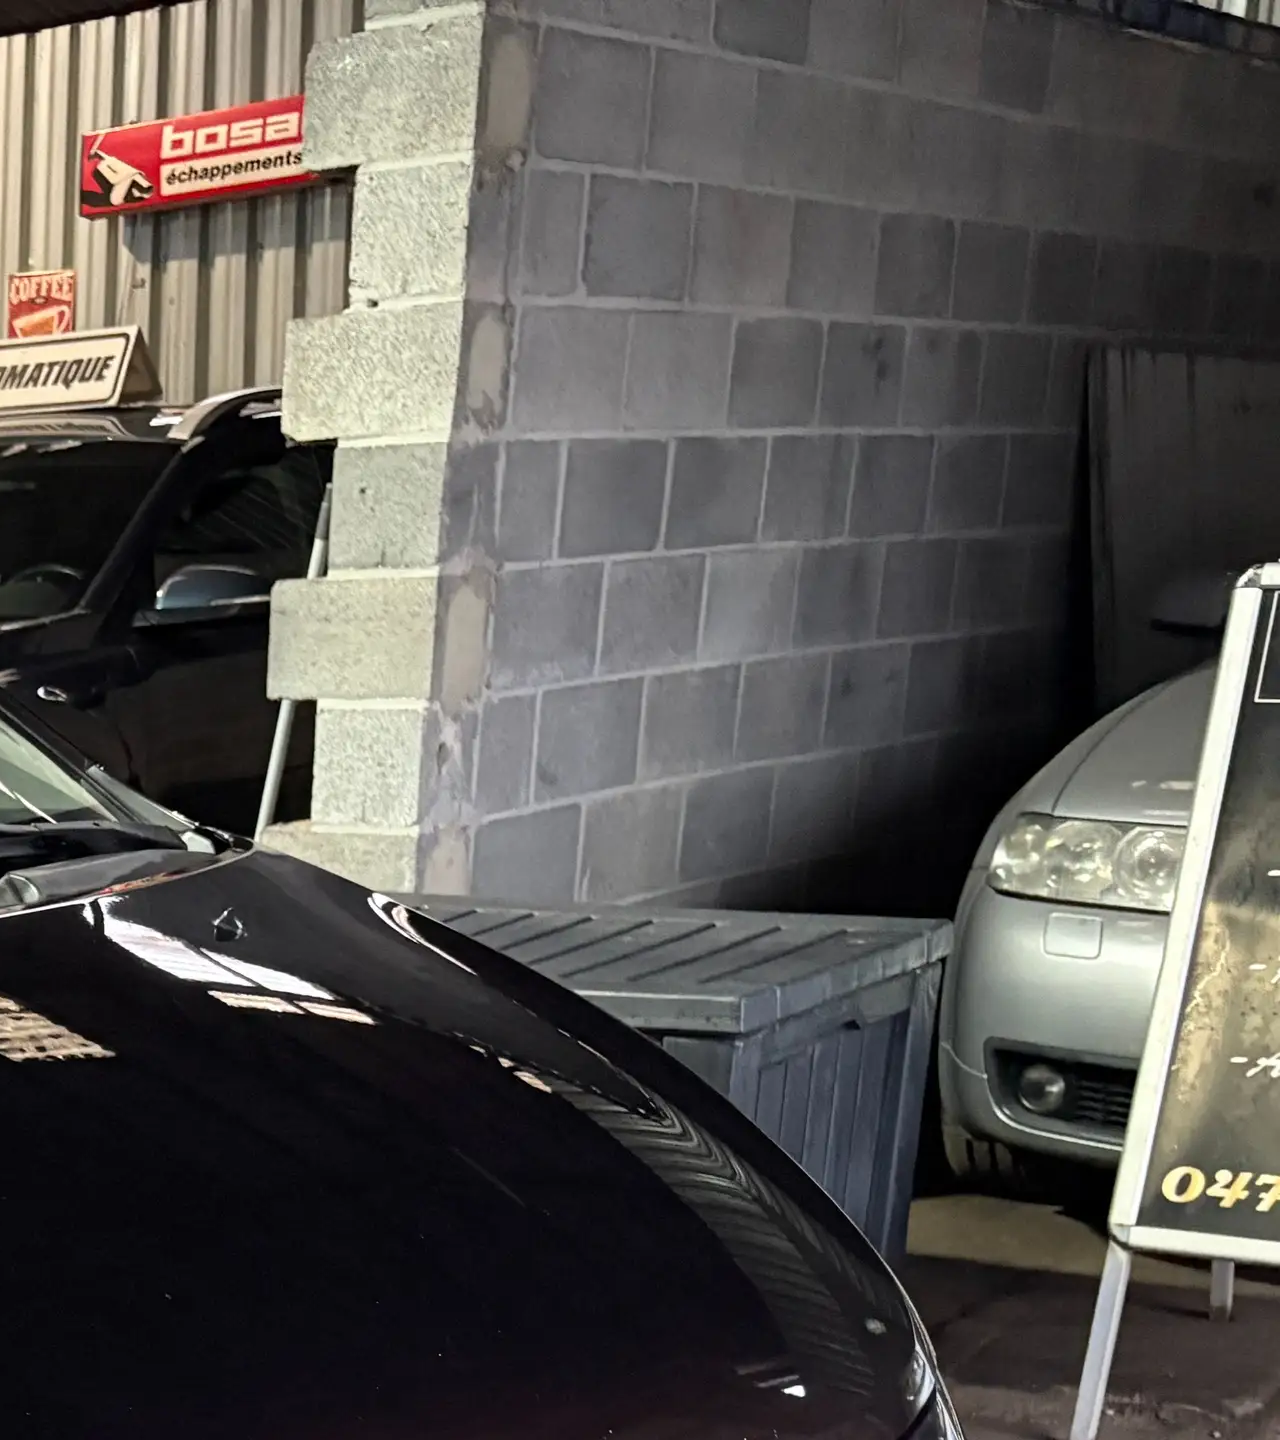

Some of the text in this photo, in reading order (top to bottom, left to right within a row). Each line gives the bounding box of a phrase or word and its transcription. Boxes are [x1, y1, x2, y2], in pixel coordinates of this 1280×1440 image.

[160, 112, 300, 160] bosa
[165, 149, 303, 186] échappements
[10, 277, 73, 305] COFFEE
